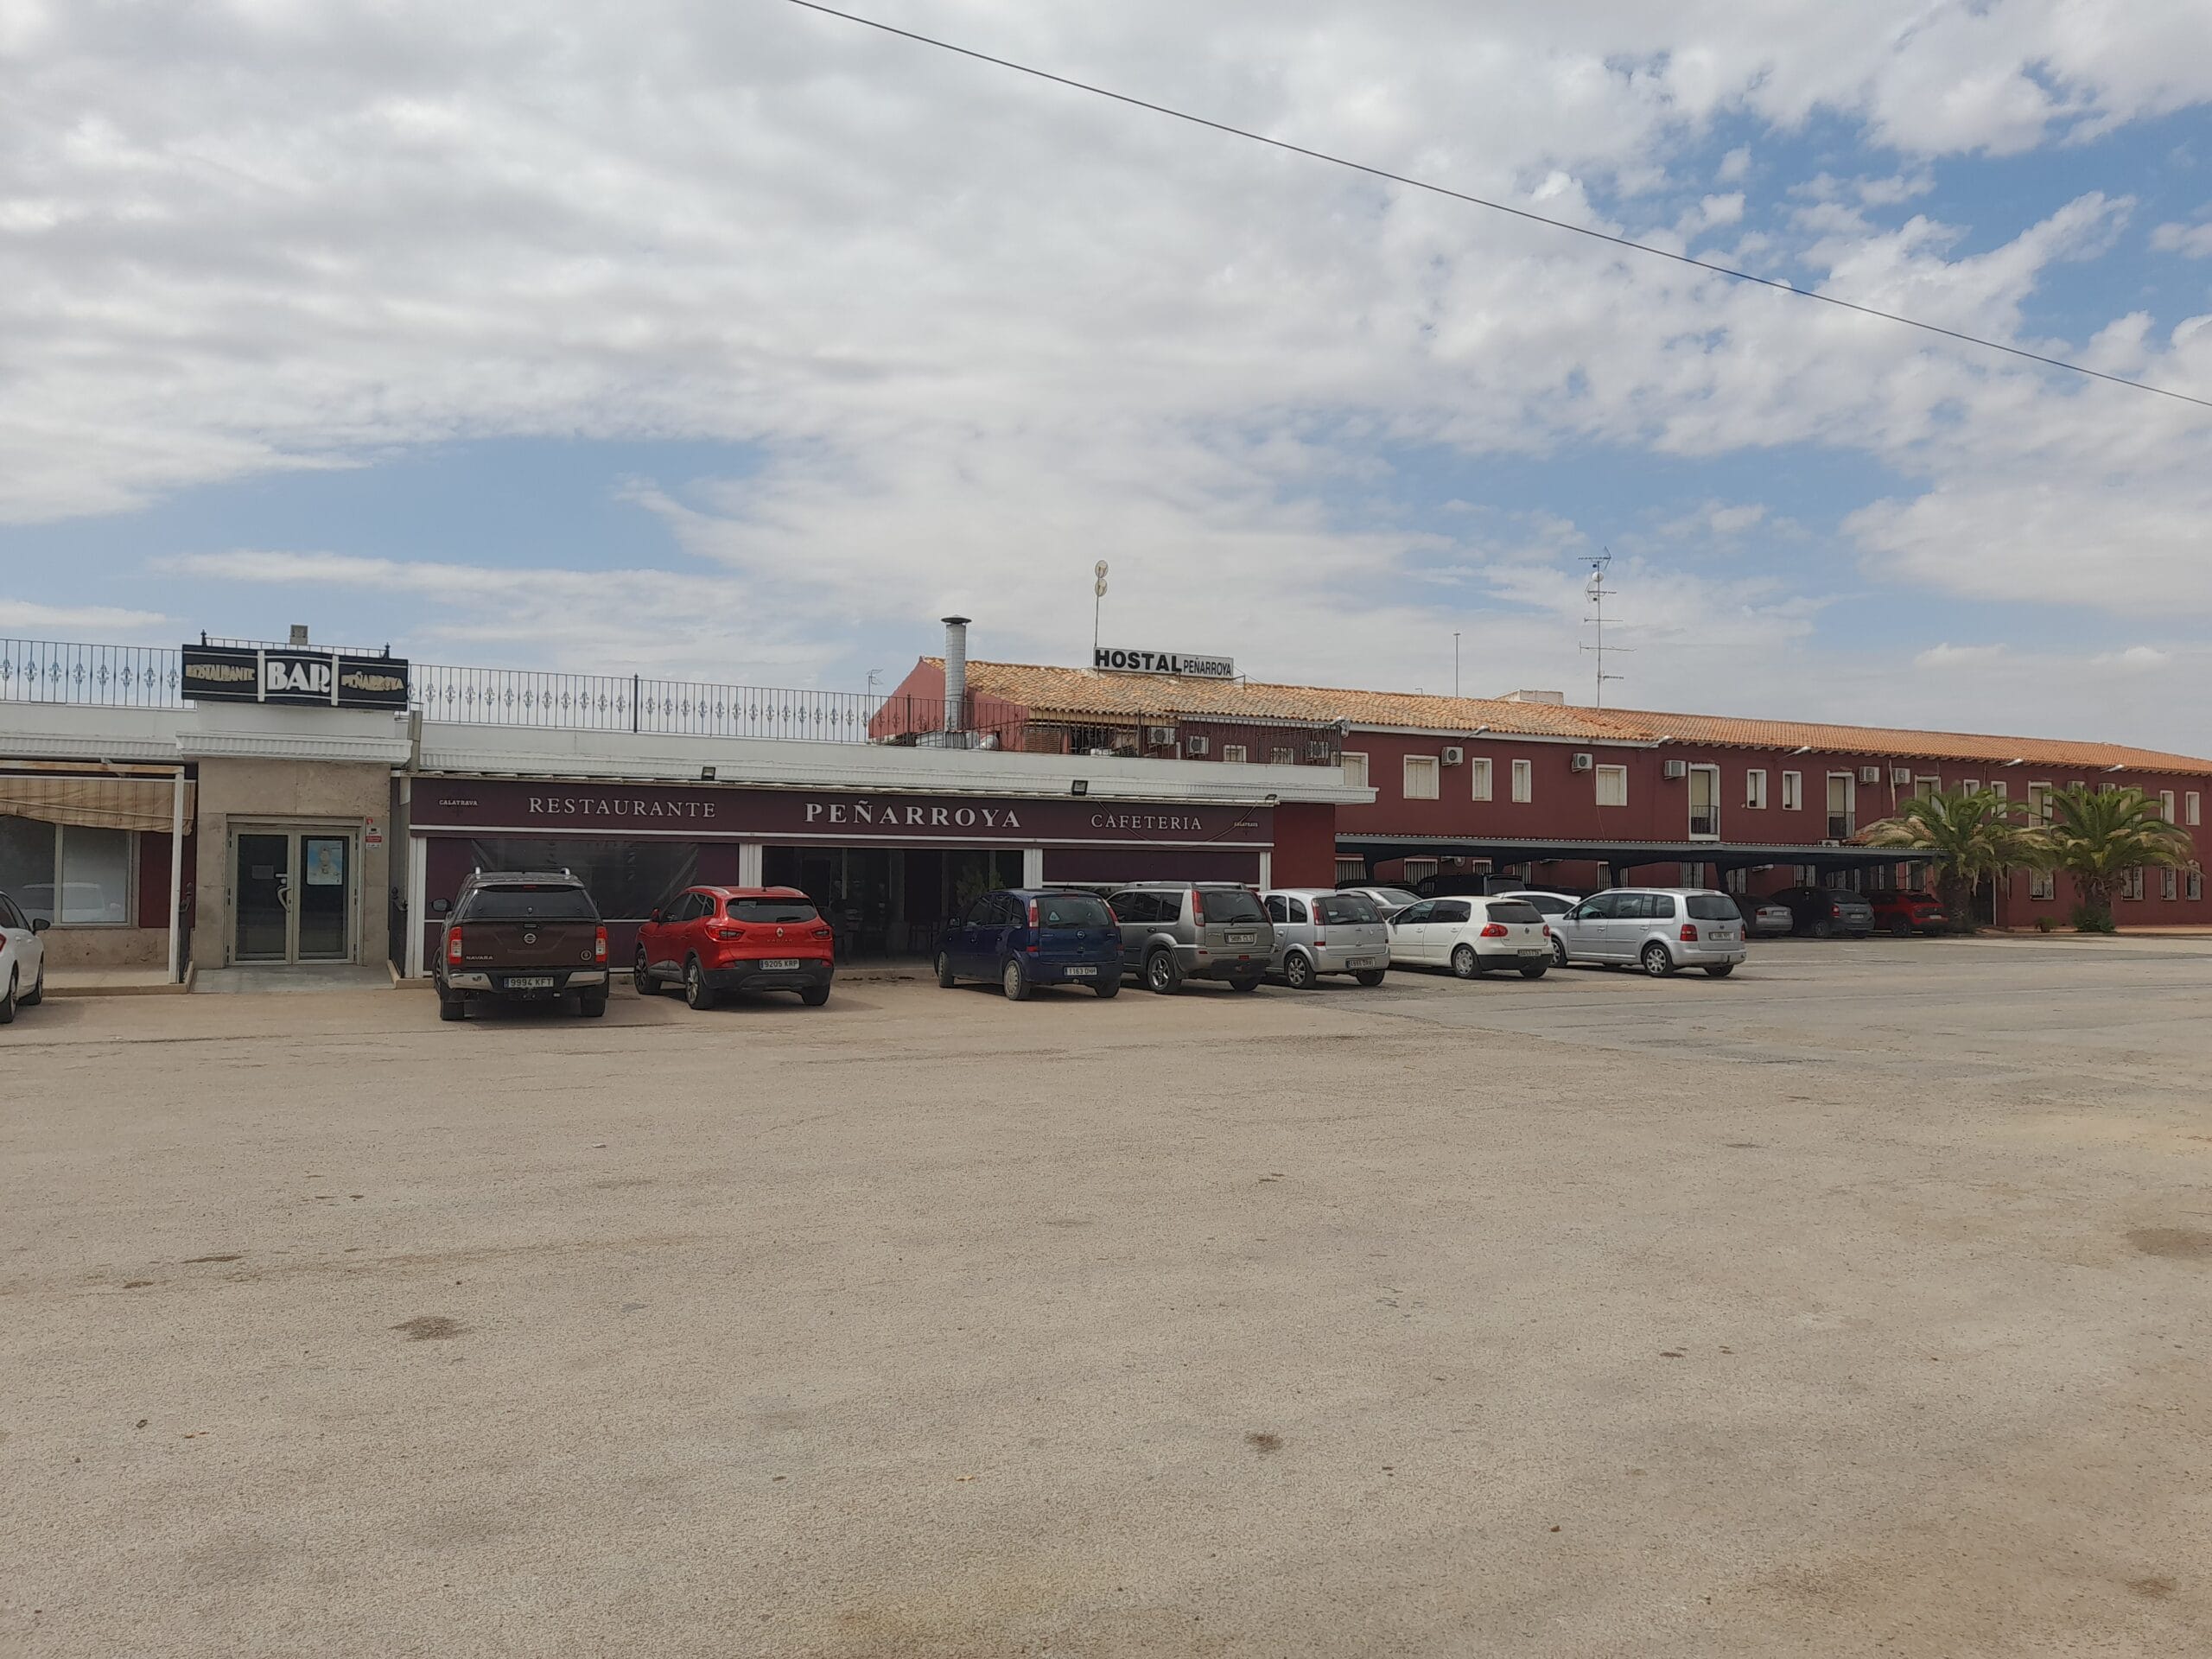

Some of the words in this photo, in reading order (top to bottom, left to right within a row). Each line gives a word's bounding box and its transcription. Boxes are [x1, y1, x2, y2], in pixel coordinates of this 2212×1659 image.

[1095, 650, 1182, 672] HOSTAL
[1183, 658, 1232, 676] PEÑARROYA
[266, 662, 331, 694] BAR
[438, 798, 479, 807] CALATRAVA
[528, 798, 716, 818] RESTAURANTE
[804, 799, 1021, 828] PEÑARROYA
[1090, 814, 1203, 830] CAFETERIA
[511, 978, 532, 987] 9994
